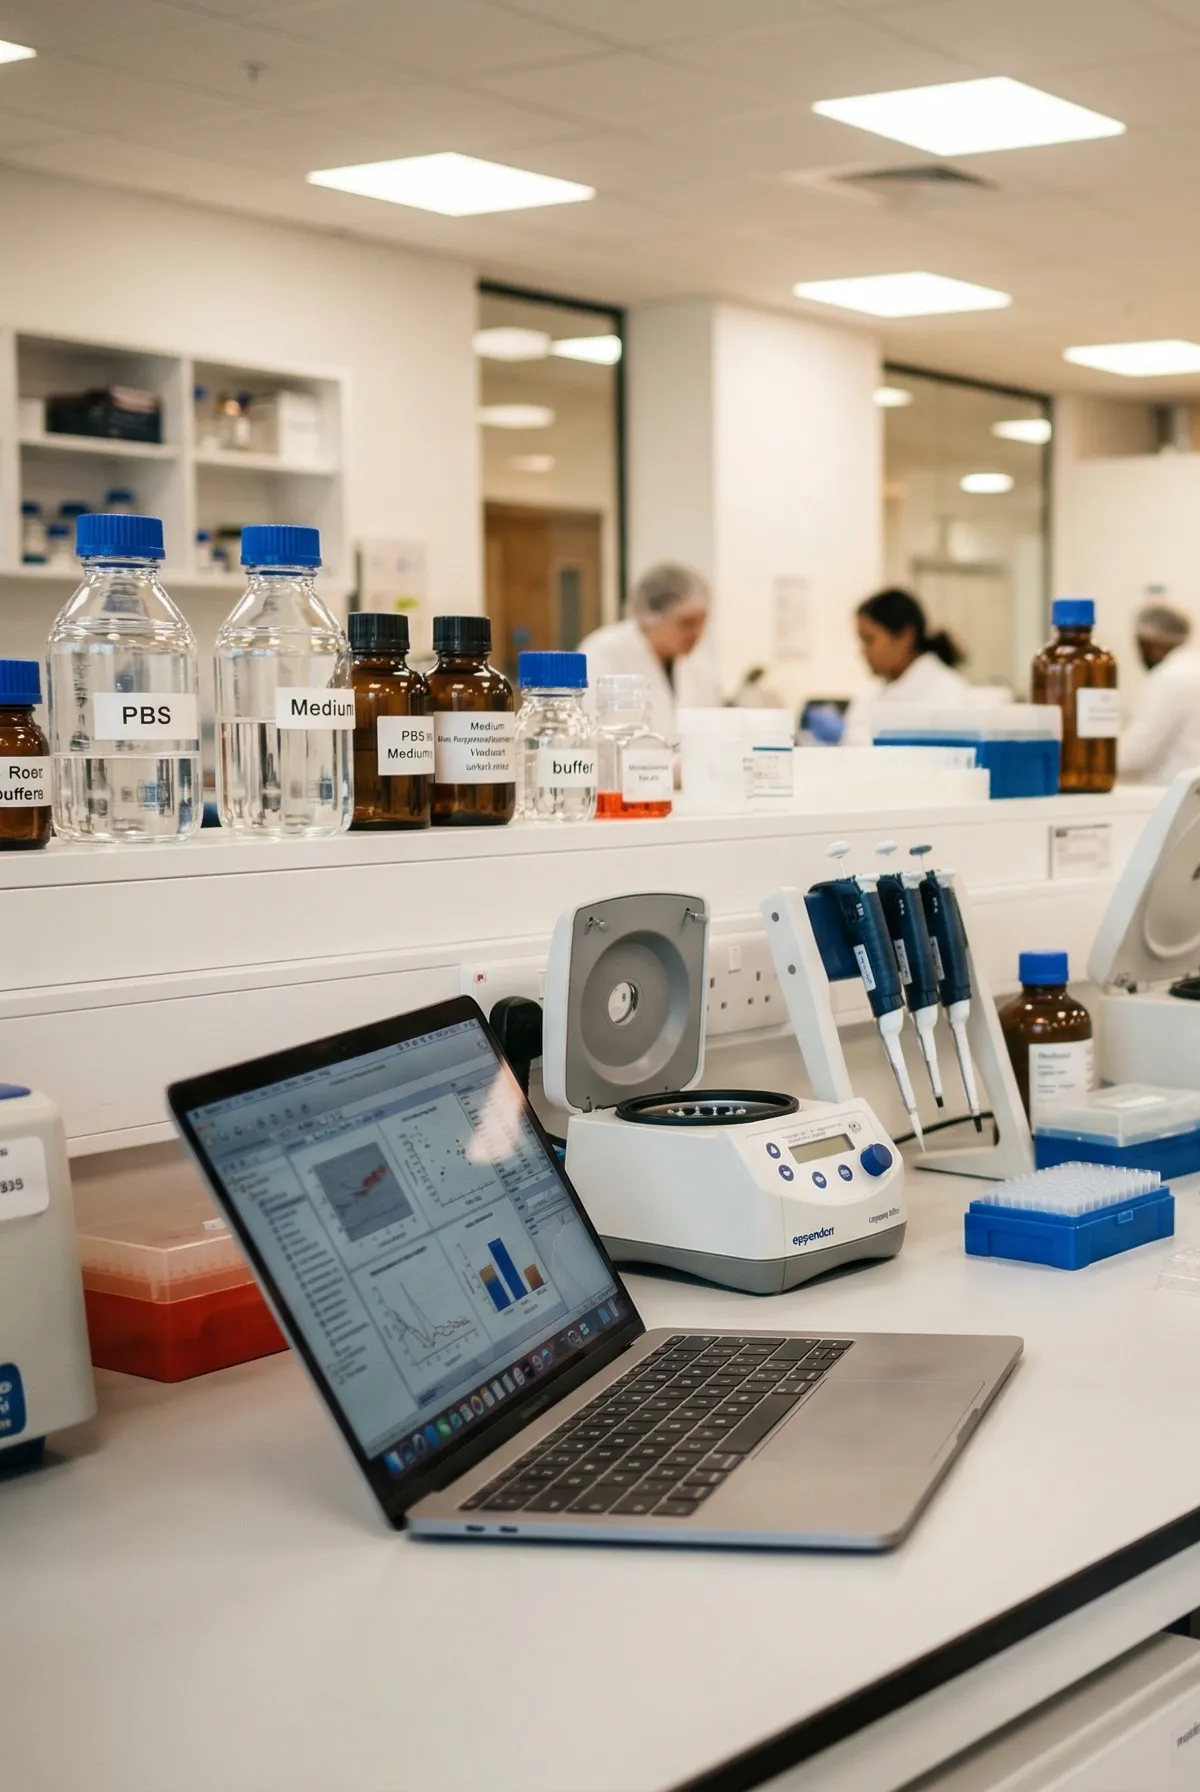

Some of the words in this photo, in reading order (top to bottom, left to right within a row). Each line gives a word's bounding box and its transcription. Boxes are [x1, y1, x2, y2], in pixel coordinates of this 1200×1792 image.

[291, 699, 354, 716] Medium
[122, 706, 171, 725] PBS
[470, 722, 505, 731] Medium
[401, 730, 425, 742] PBS
[552, 760, 594, 774] buffer
